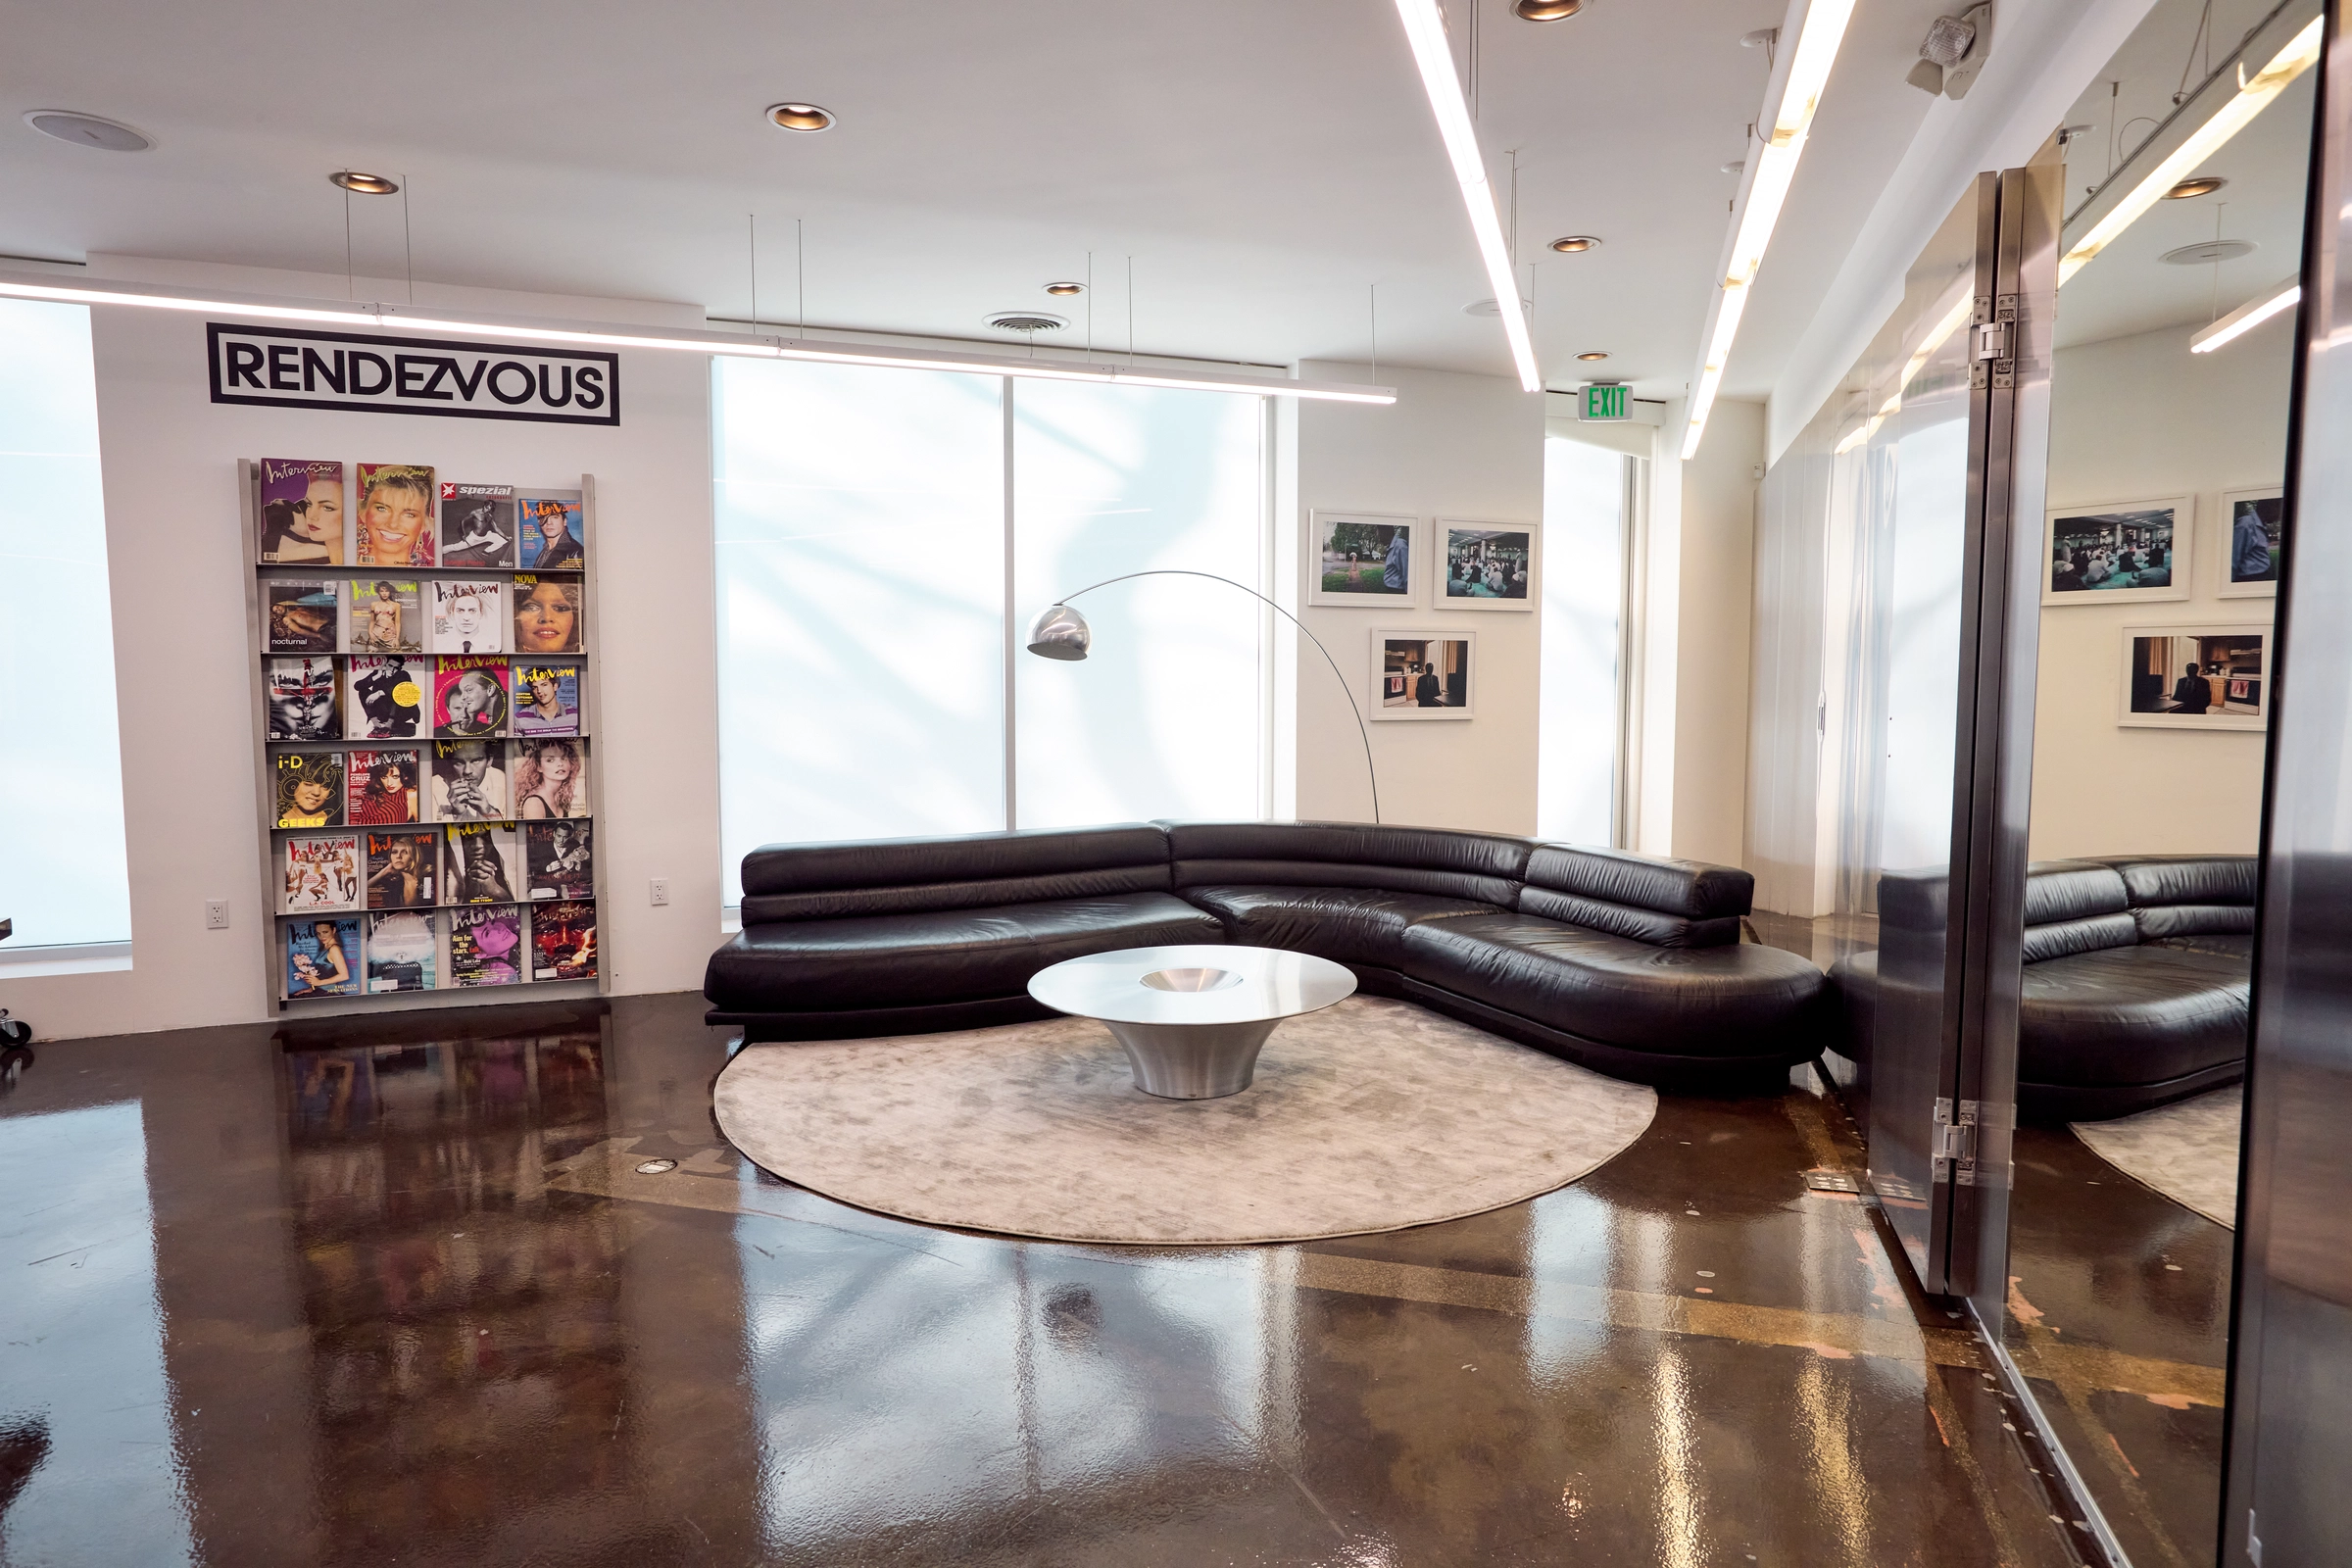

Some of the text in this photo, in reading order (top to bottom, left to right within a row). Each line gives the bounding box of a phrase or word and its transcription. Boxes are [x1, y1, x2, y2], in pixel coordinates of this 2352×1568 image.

[225, 341, 605, 410] RENDEZVOUS
[1589, 387, 1627, 417] EXIT
[266, 461, 338, 484] Interview
[459, 486, 513, 495] spezial
[520, 500, 581, 520] Interview
[514, 574, 538, 584] NOVA
[434, 581, 499, 603] Interview
[437, 655, 508, 675] Interview
[515, 666, 575, 686] Interview
[278, 756, 303, 769] i-D
[349, 751, 416, 773] Interview
[278, 817, 325, 829] GEEKS
[449, 906, 518, 931] Interview
